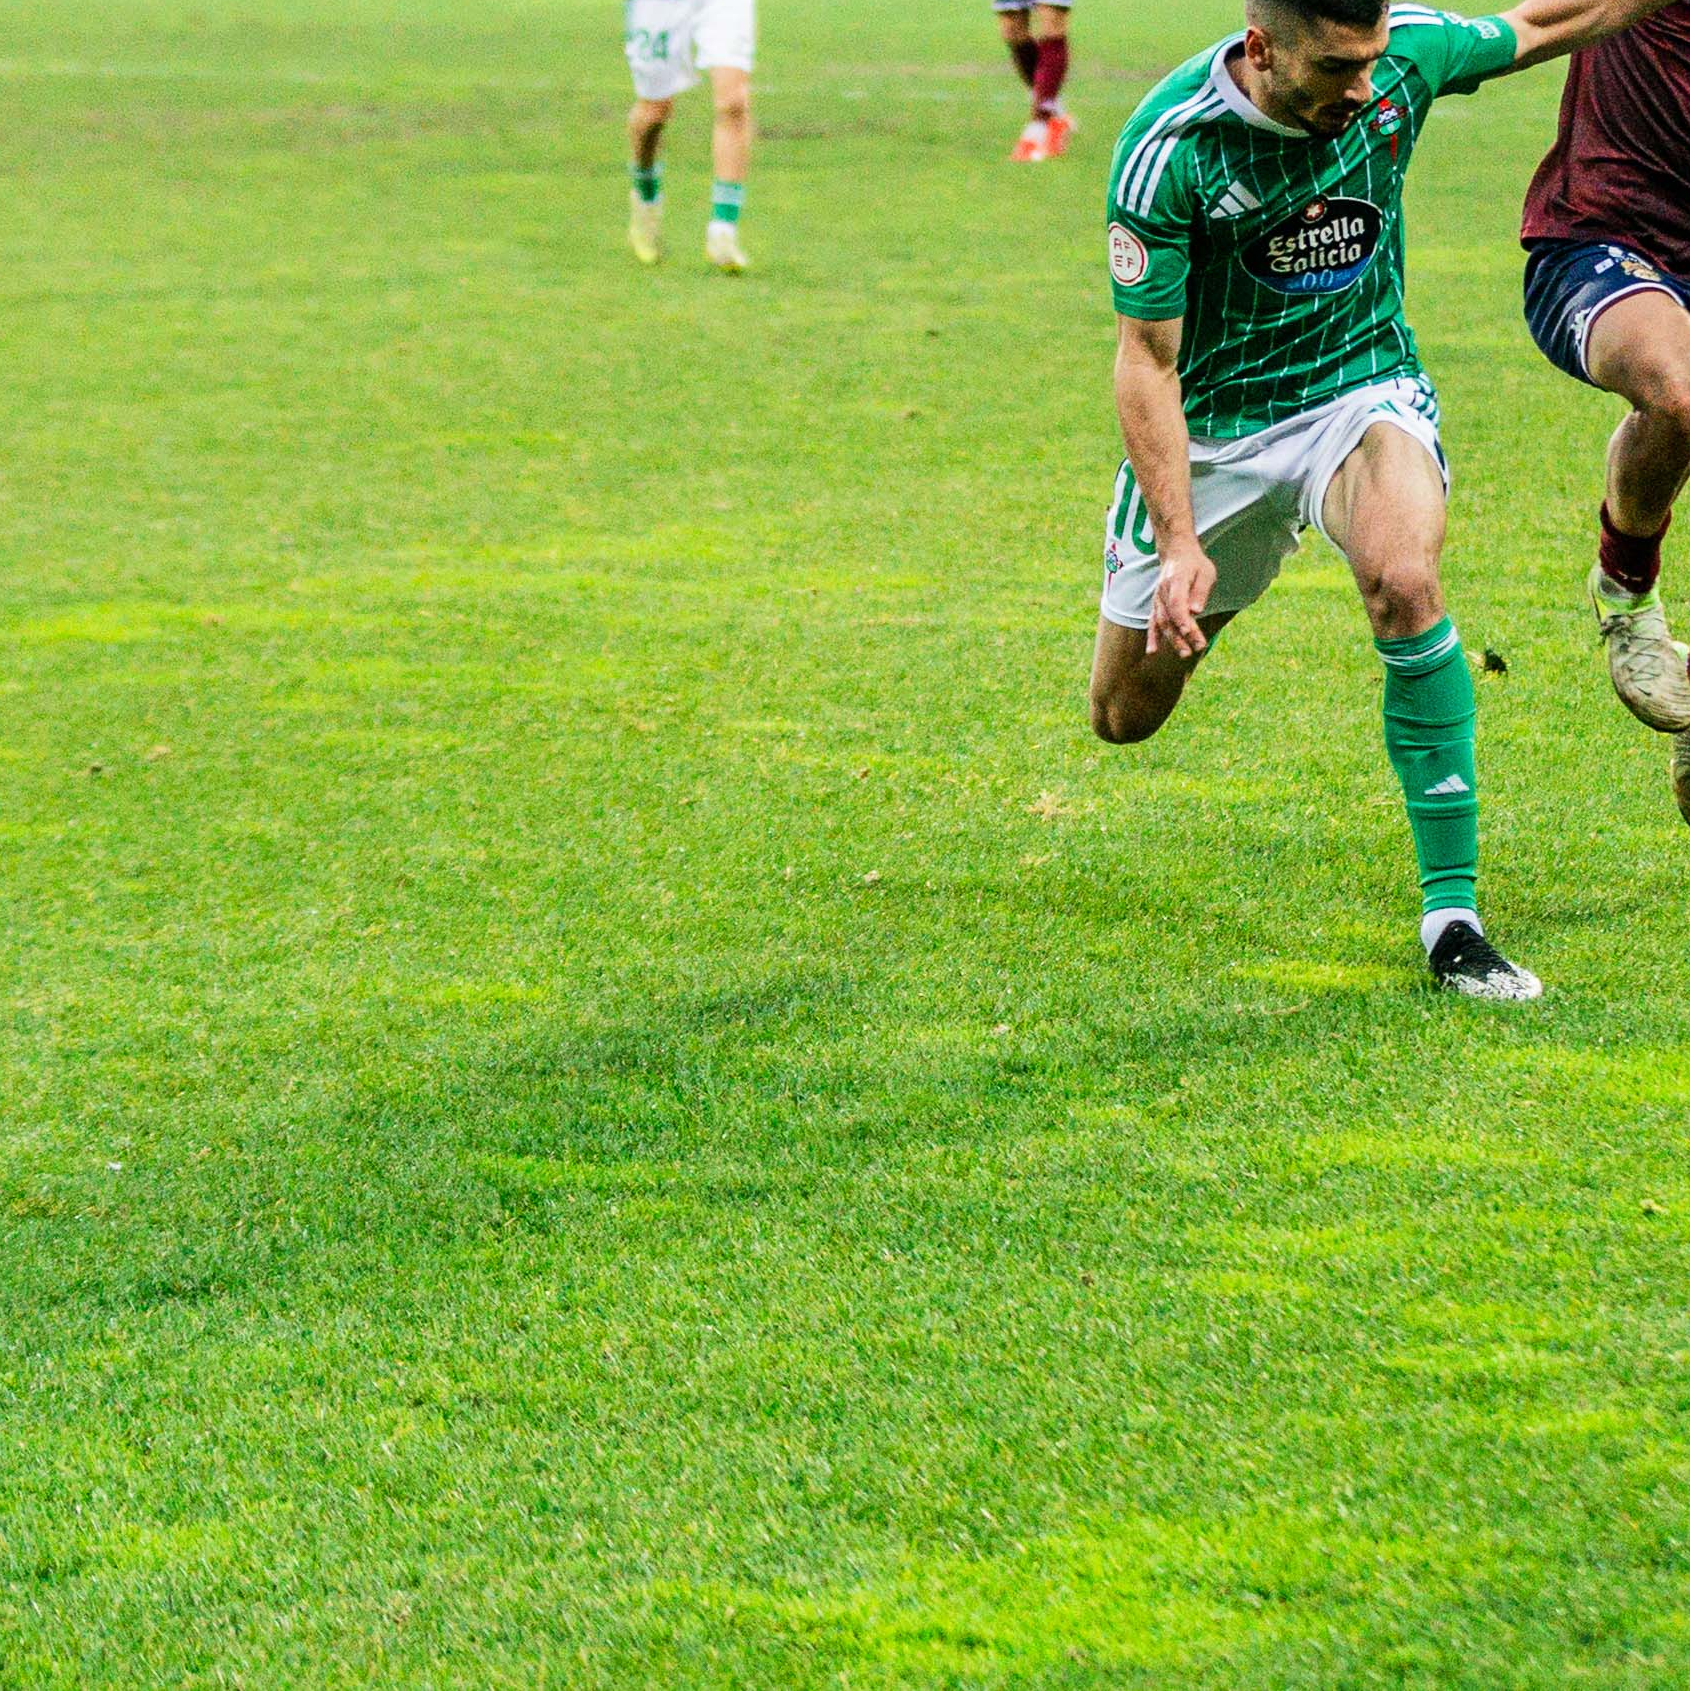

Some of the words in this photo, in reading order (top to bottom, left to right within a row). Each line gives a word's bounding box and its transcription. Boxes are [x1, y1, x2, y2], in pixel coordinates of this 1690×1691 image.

[1266, 216, 1365, 257] Estrella
[1270, 241, 1362, 273] Galicia
[1113, 462, 1157, 556] 10
